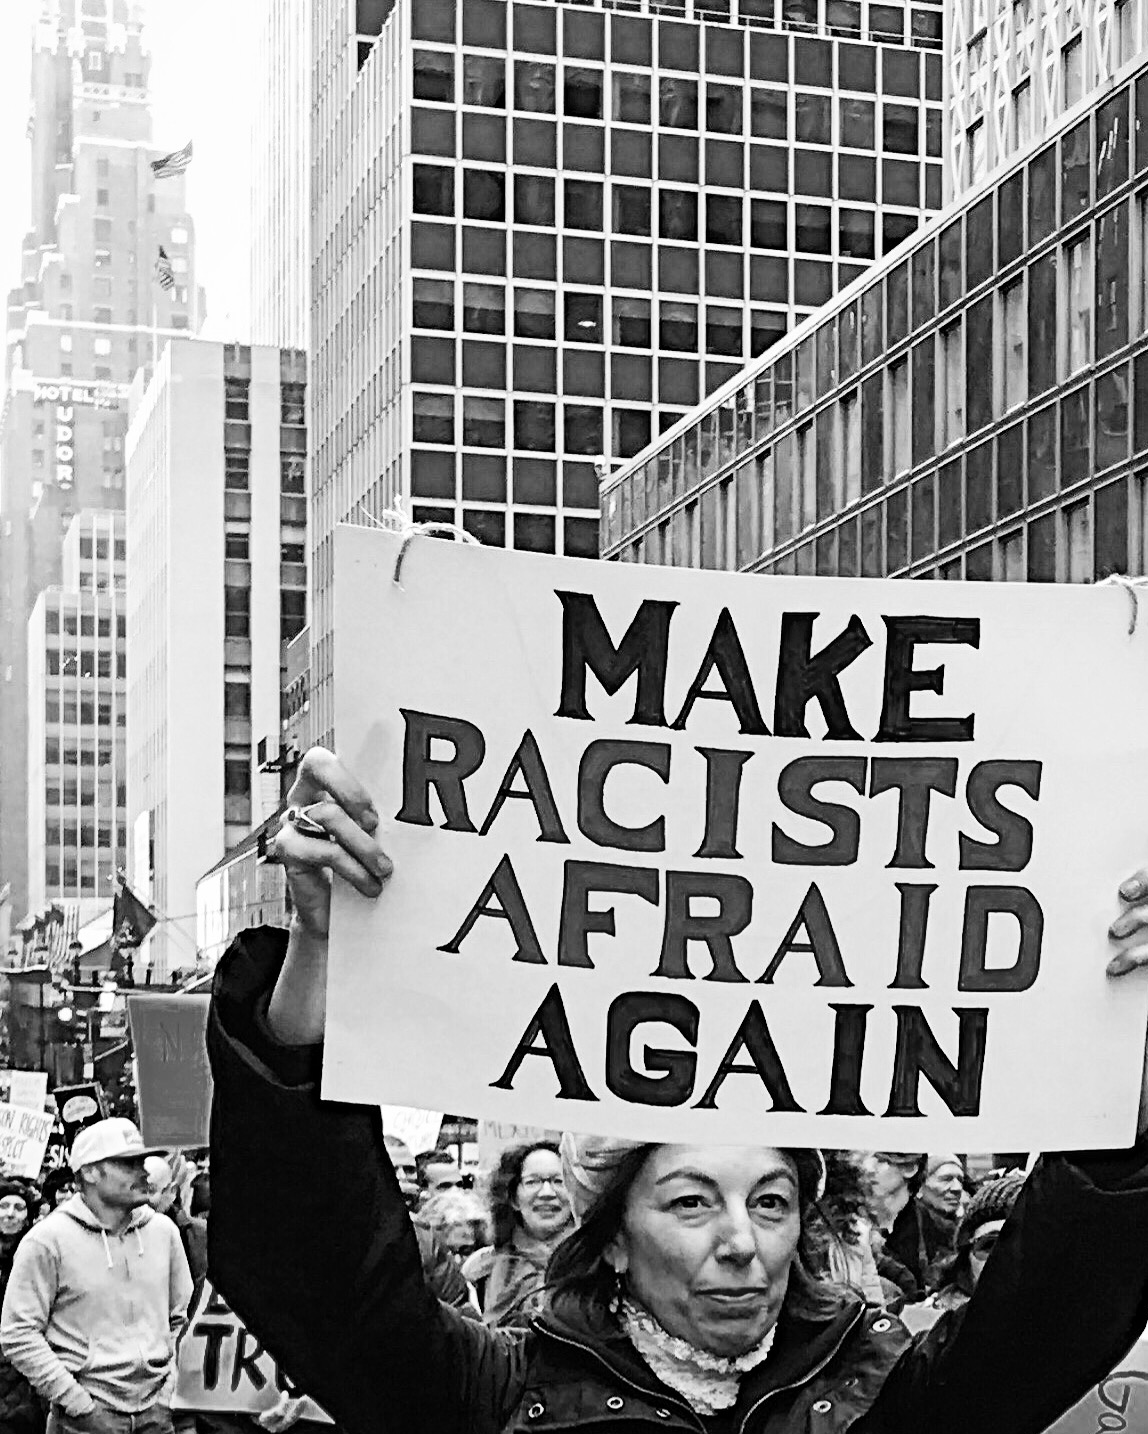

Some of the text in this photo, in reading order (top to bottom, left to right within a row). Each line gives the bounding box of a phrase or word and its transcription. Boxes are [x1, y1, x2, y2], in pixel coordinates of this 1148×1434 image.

[553, 588, 981, 743] MAKE
[394, 707, 1043, 873] RACISTS
[436, 853, 1045, 993] AFRAID
[488, 982, 990, 1118] AGAIN
